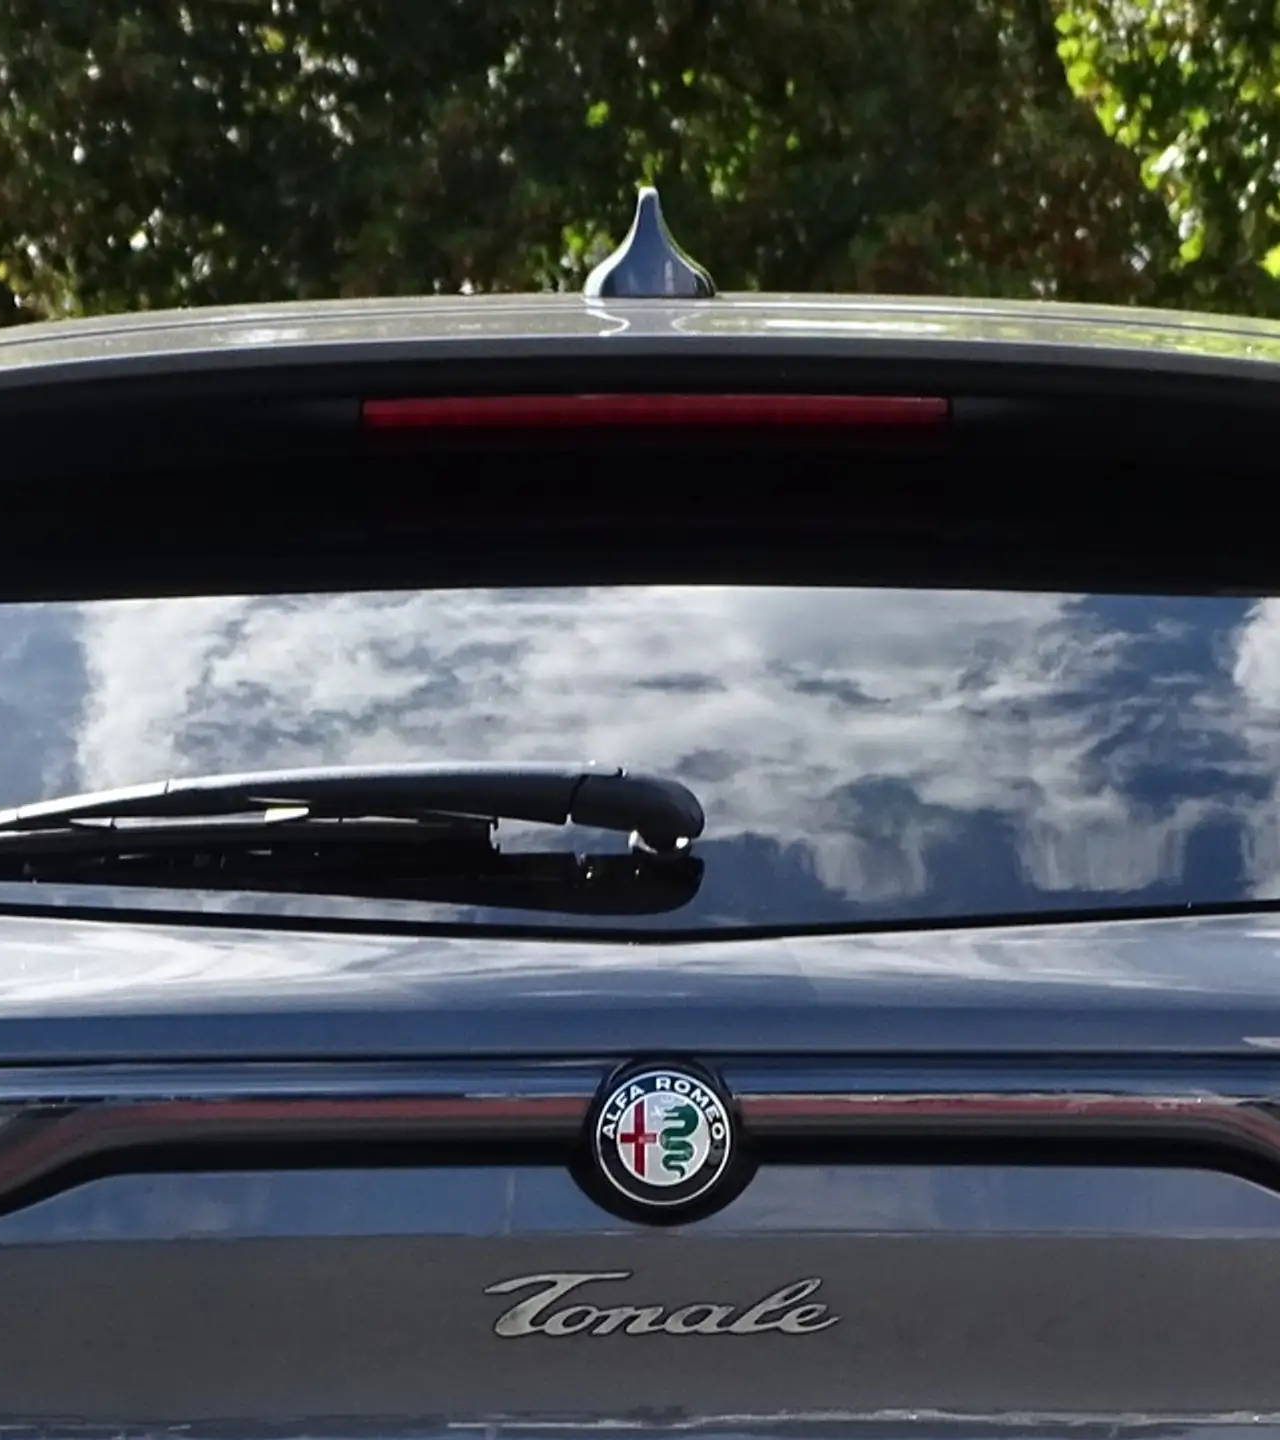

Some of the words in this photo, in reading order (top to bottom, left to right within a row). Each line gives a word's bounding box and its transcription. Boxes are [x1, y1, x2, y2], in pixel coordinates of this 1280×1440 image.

[602, 1084, 645, 1140] ALFA
[655, 1076, 726, 1140] ROMEO
[483, 1270, 842, 1339] Tonale
